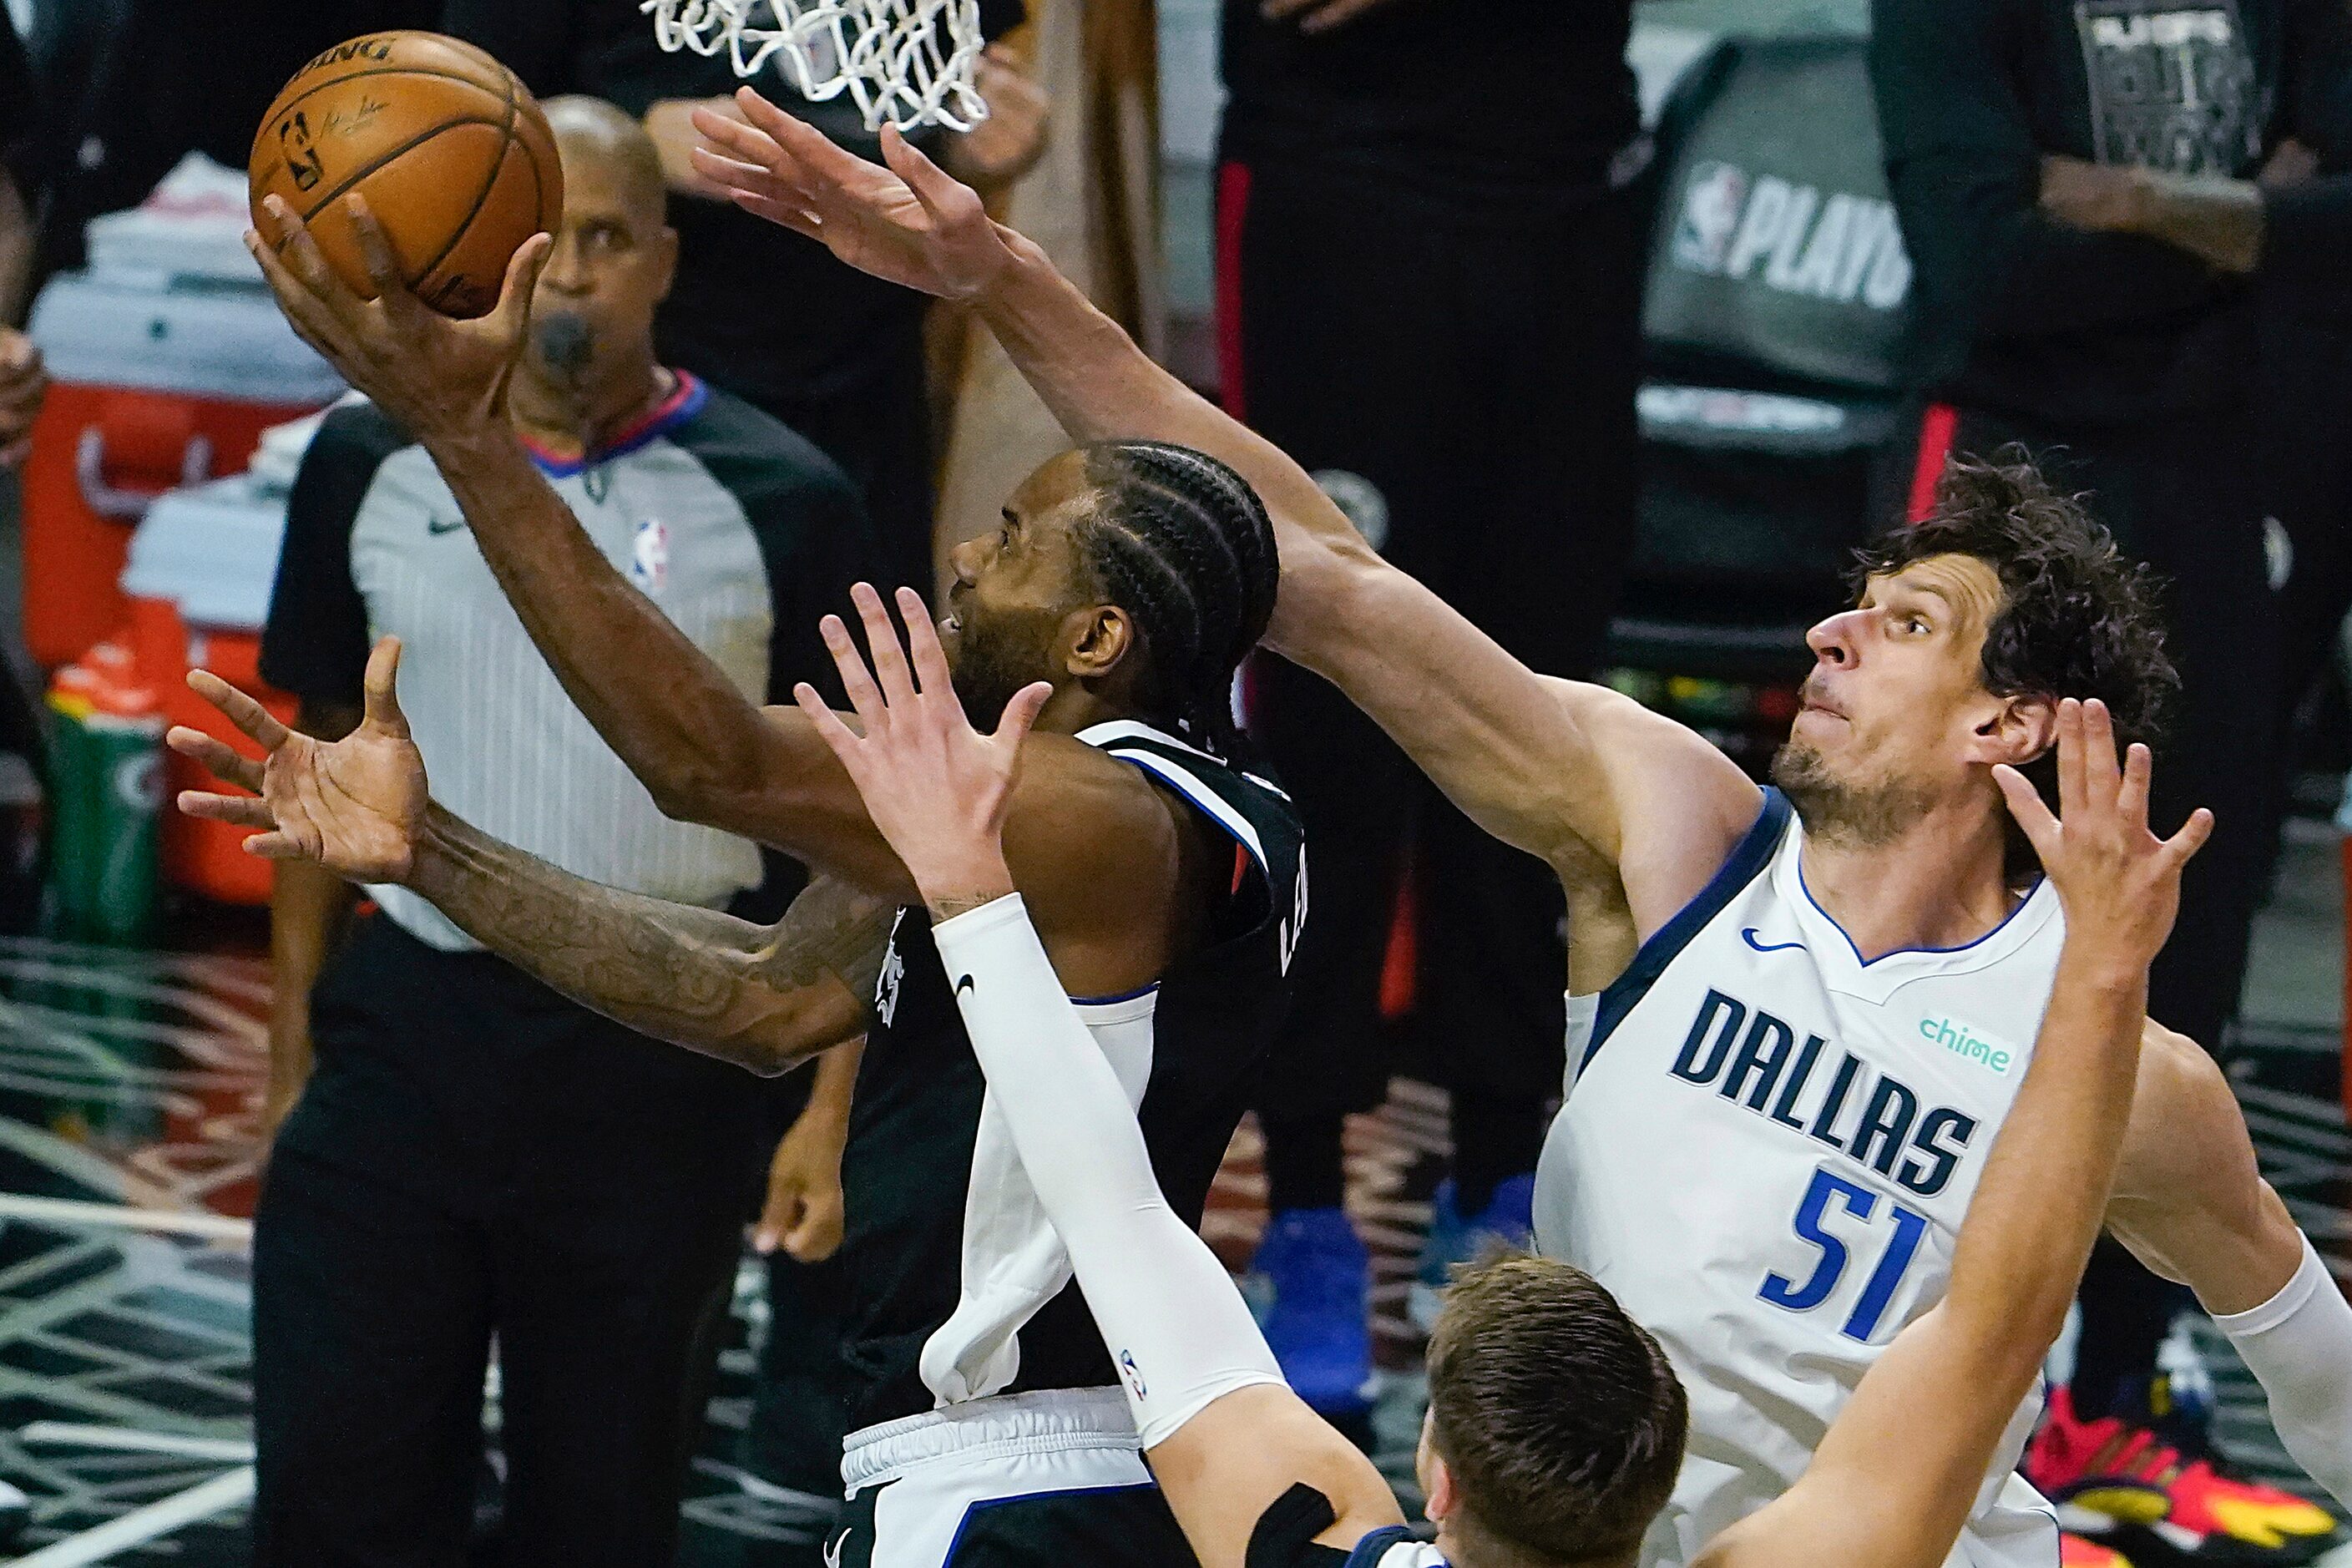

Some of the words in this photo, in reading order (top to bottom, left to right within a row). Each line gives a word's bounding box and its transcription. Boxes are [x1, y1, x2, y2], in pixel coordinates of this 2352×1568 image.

[1668, 986, 1980, 1198] DALLAS
[1920, 1019, 2011, 1072] chime
[1755, 1165, 1930, 1344] 51
